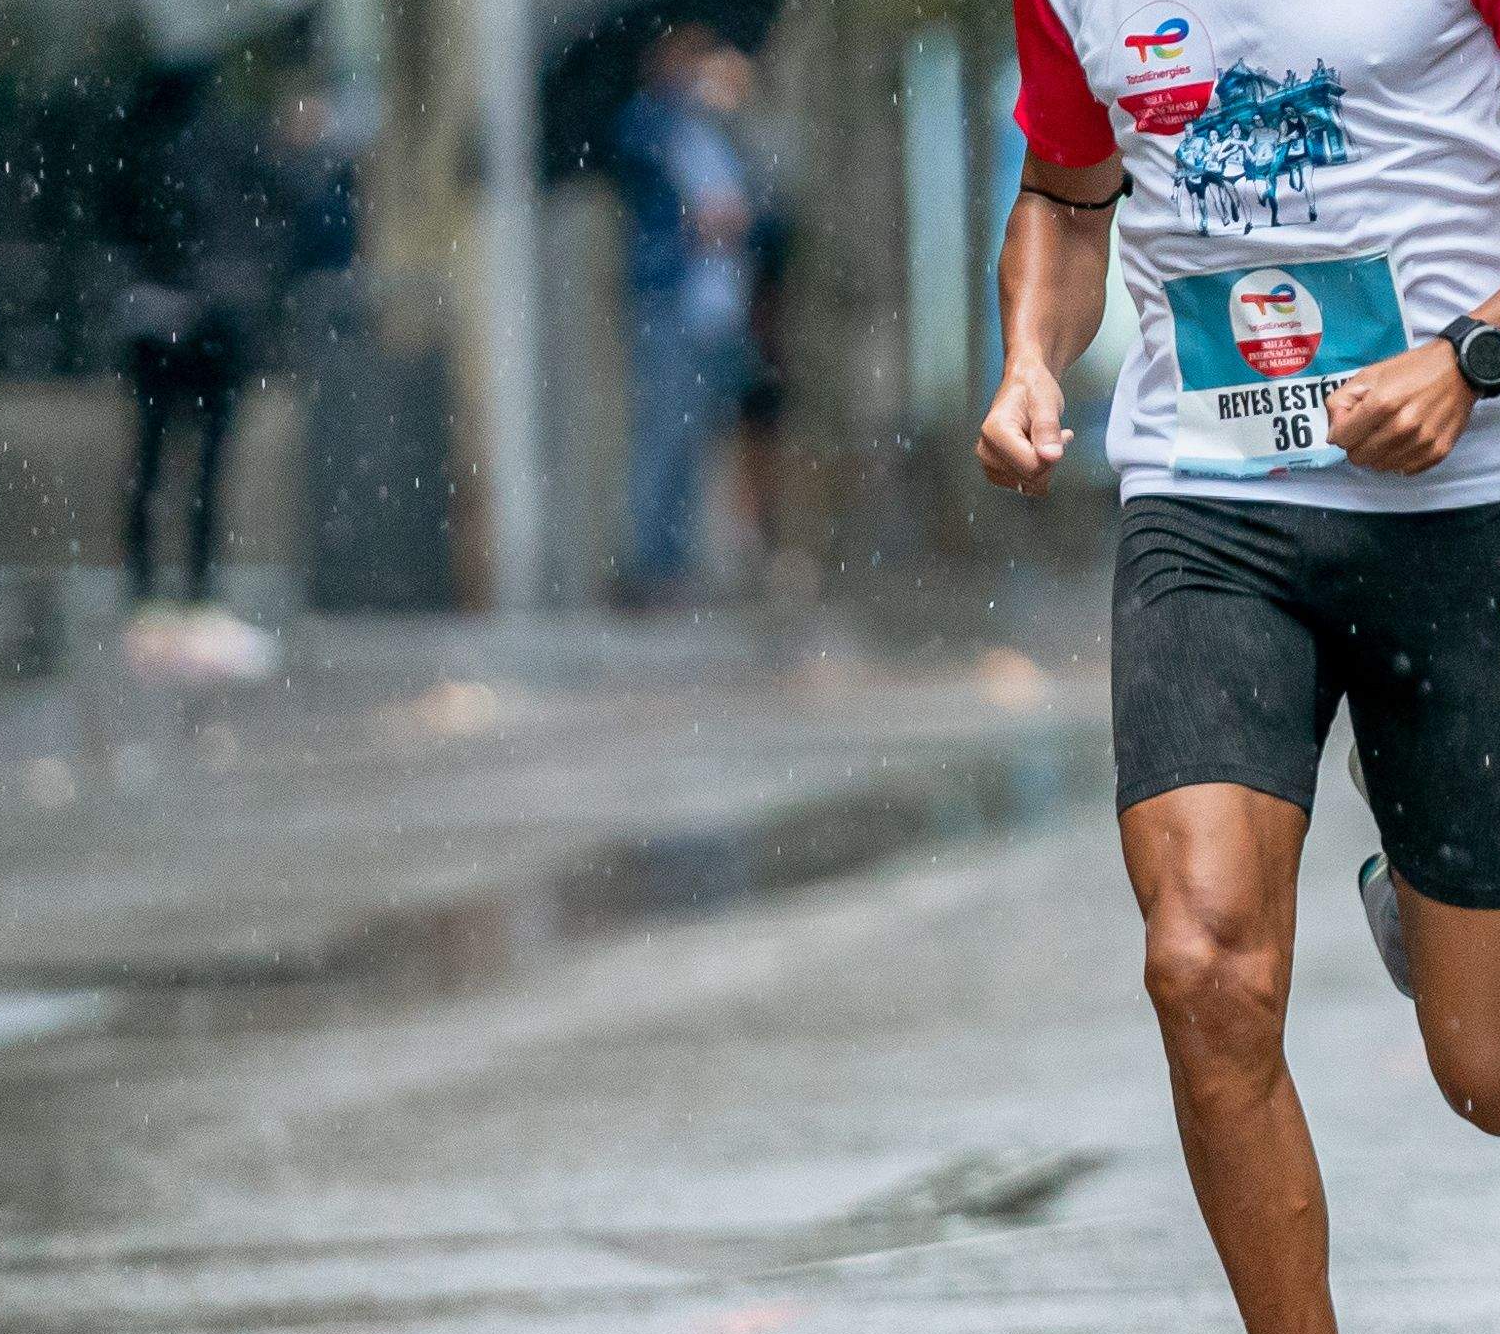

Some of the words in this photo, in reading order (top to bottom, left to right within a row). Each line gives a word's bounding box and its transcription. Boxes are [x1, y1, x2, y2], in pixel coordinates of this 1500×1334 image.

[1126, 65, 1191, 85] TotalEnergies
[1219, 387, 1274, 420] REYES
[1273, 414, 1313, 451] 36
